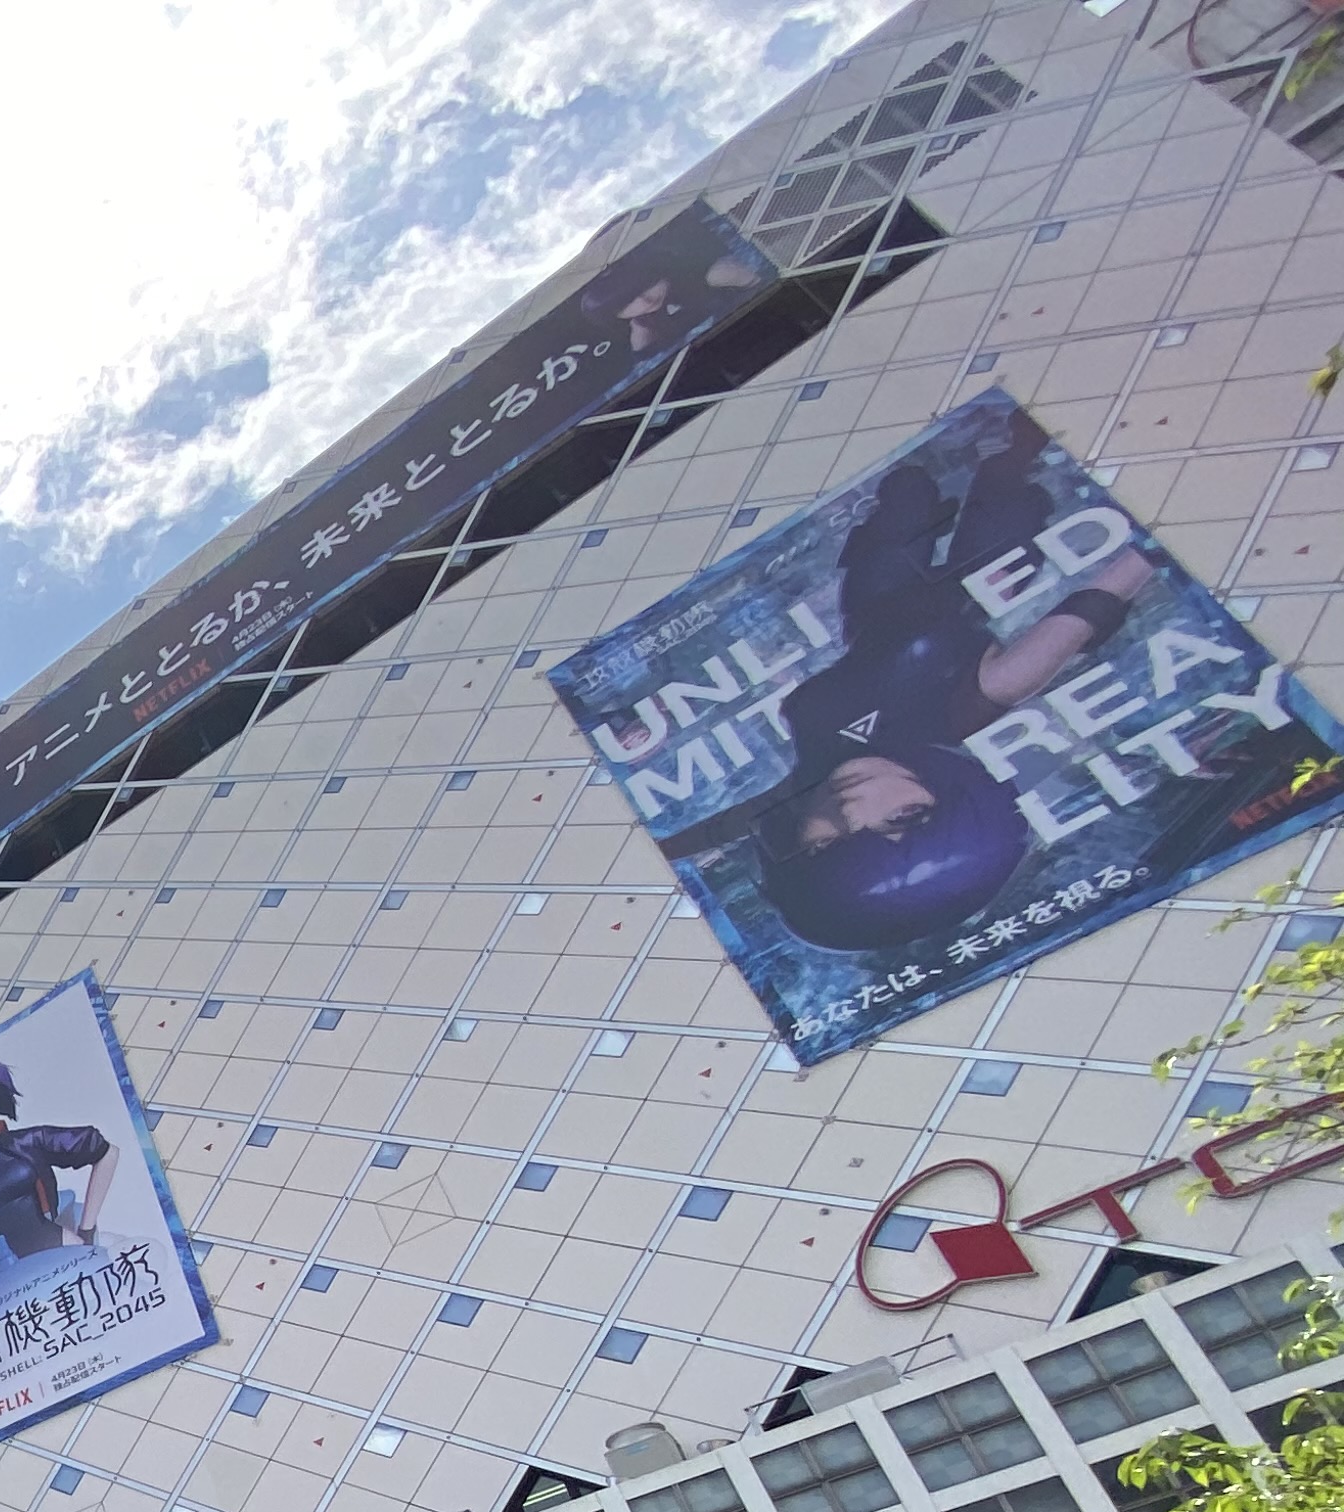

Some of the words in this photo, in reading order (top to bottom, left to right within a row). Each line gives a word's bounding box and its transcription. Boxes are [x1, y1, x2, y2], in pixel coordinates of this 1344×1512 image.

[592, 600, 833, 767] UNLI
[624, 681, 802, 819] MIT
[960, 505, 1132, 620] ED
[963, 626, 1244, 784] REA
[1015, 663, 1294, 847] LITY
[790, 864, 1152, 1042] あなたは、未来を視る。
[42, 1287, 166, 1360] SAC_2045
